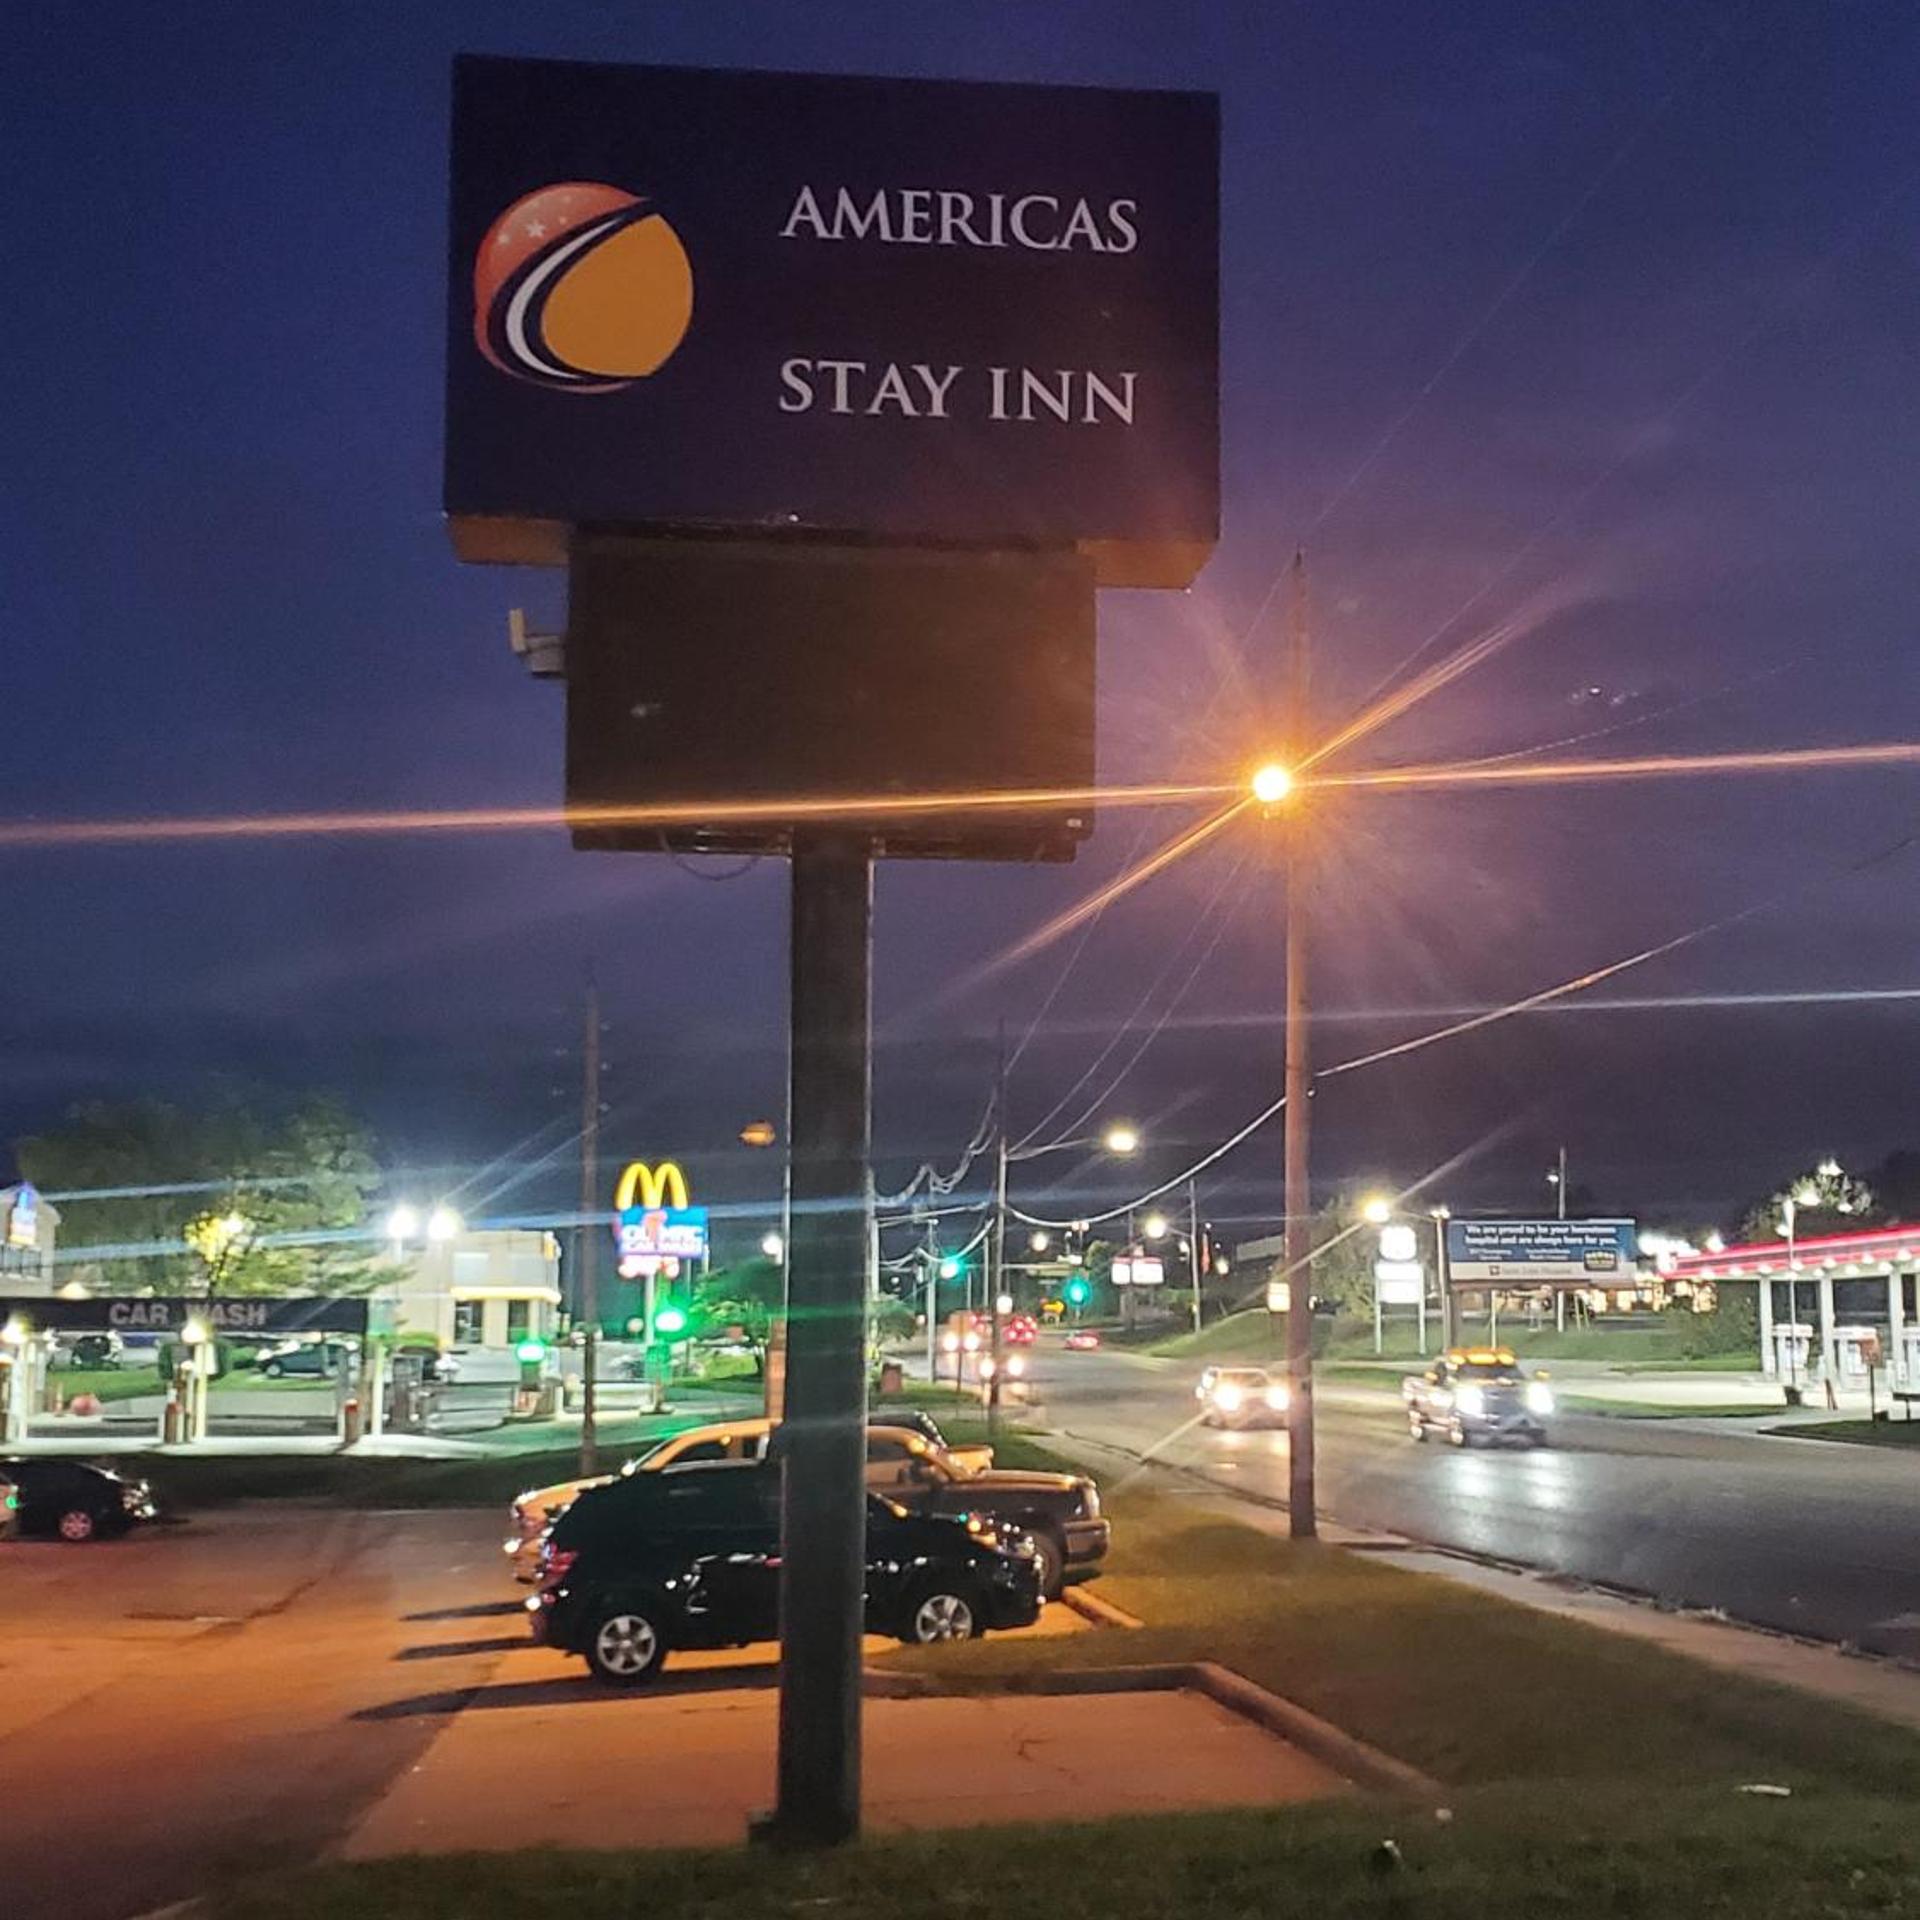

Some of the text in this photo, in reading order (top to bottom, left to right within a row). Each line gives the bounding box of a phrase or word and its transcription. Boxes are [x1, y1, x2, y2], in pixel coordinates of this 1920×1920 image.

[778, 184, 1139, 254] AMERICAS
[778, 358, 1139, 426] STAY INN
[109, 1303, 267, 1326] CAR WASH
